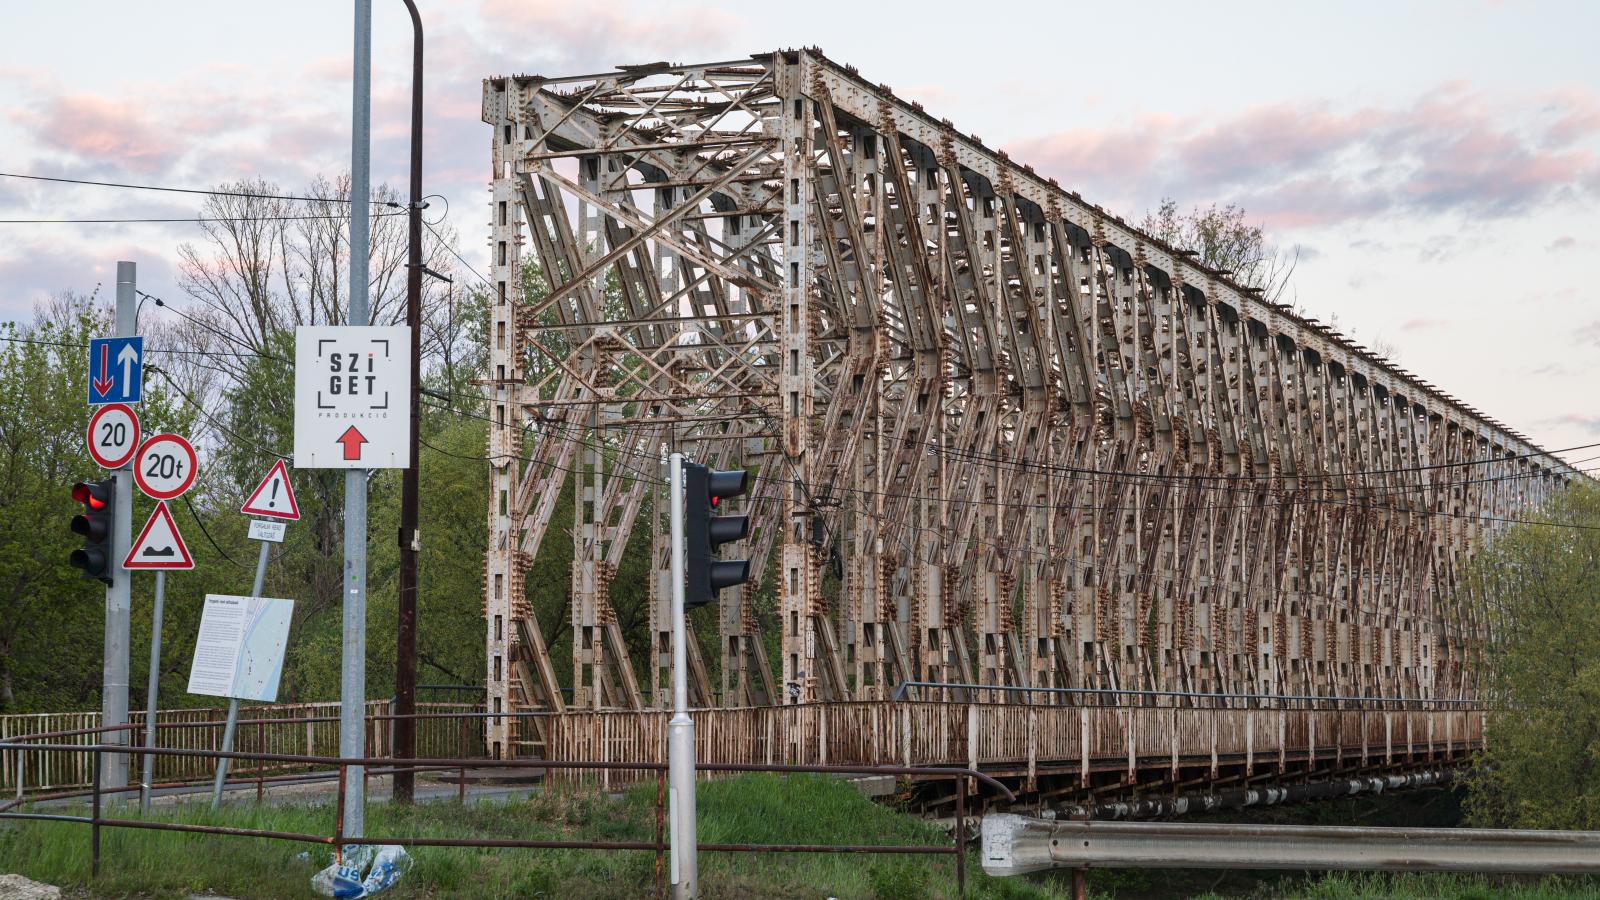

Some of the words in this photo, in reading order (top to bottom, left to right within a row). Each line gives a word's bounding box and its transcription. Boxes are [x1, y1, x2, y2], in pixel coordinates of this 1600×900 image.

[330, 375, 376, 395] GET
[101, 422, 125, 447] 20
[146, 453, 183, 480] 20t
